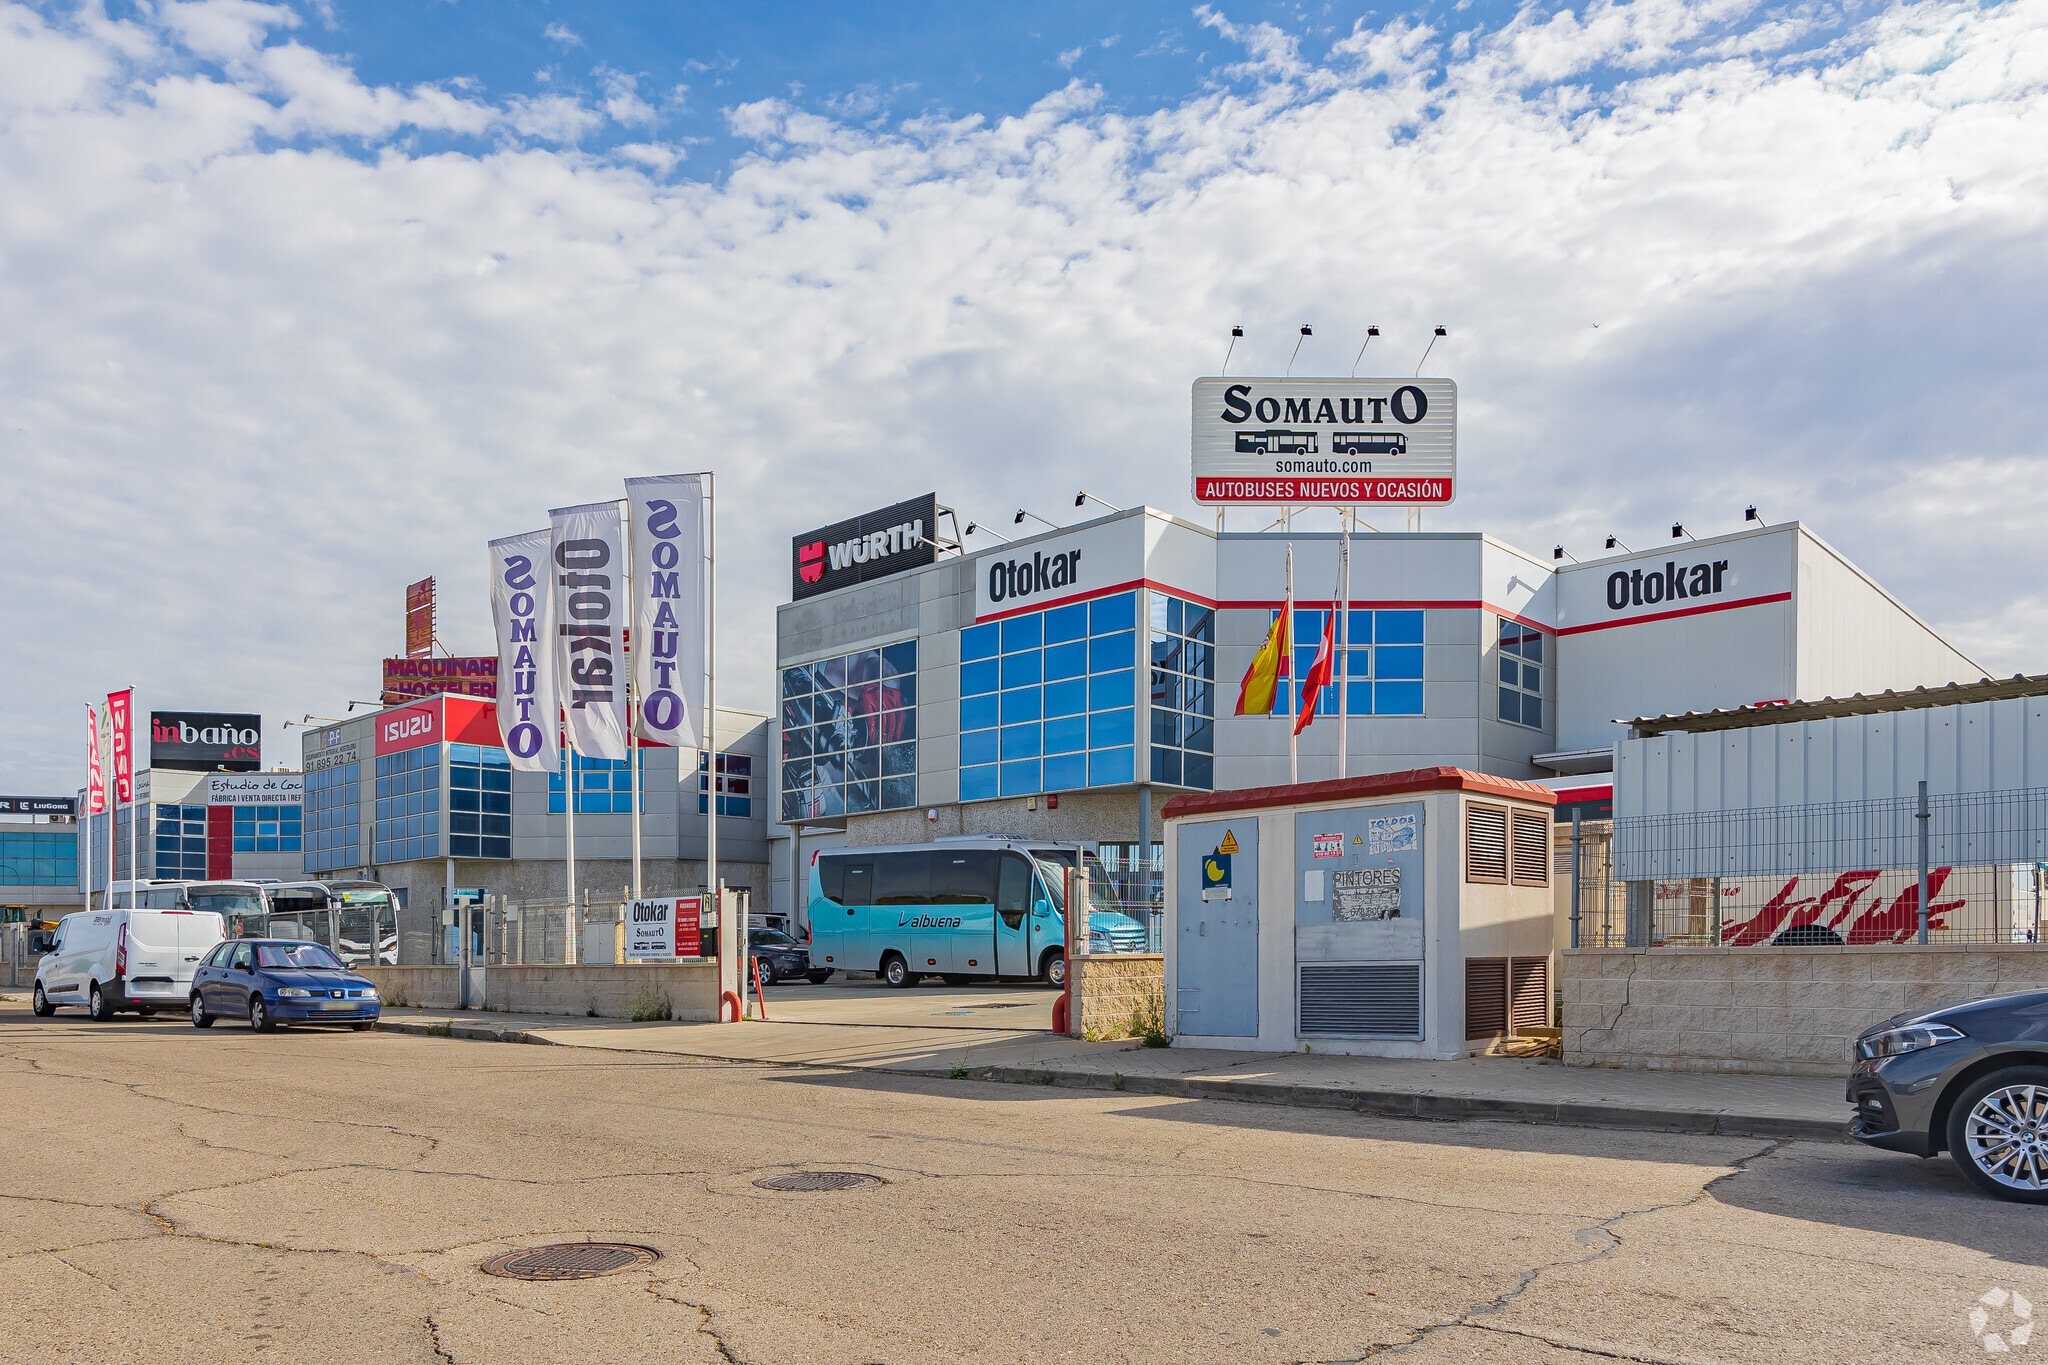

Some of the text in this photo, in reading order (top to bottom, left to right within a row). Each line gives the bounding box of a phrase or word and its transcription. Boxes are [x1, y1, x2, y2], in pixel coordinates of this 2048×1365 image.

[1220, 384, 1429, 424] SOMAUTO
[1275, 459, 1373, 473] somauto.com
[1205, 480, 1443, 498] AUTOBUSES NUEVOS Y OCASIÓN
[989, 548, 1082, 603] Otokar
[1606, 558, 1729, 610] Otokar
[152, 718, 259, 745] inbaño
[384, 713, 433, 742] ISUZU
[305, 750, 357, 772] 91 895 22 74
[211, 779, 259, 792] Estudio
[262, 780, 278, 790] de
[211, 794, 237, 802] FÁBRICA
[241, 793, 261, 802] VENTA
[261, 794, 287, 802] DIRECTA
[1370, 816, 1414, 828] TOLDOS
[1334, 869, 1401, 887] PINTORES
[633, 901, 669, 923] Otokar
[898, 911, 961, 928] Valbuena
